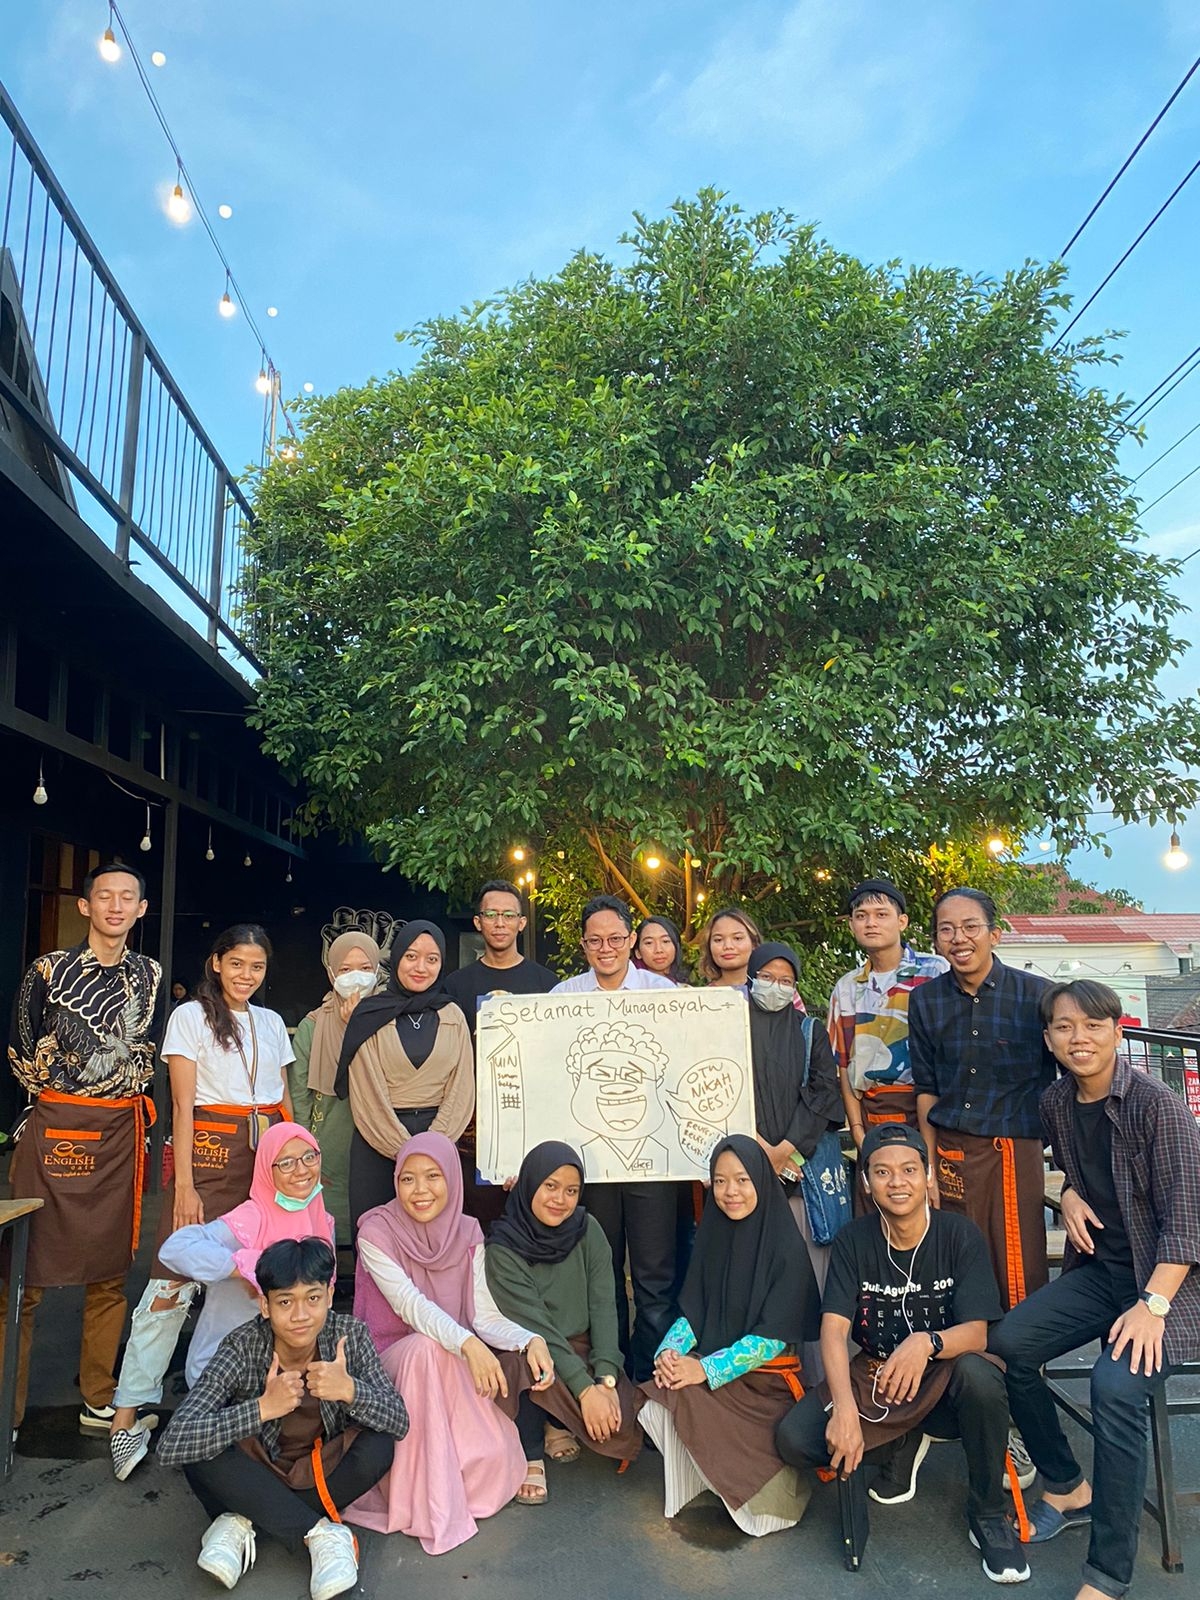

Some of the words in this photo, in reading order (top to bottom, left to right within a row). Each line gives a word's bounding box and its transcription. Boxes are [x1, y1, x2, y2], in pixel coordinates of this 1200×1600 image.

[494, 1001, 595, 1025] Selamat
[606, 996, 721, 1023] Munaqasyah
[494, 1056, 518, 1068] UIN
[687, 1062, 723, 1084] OTW
[691, 1073, 731, 1098] NIKAH
[44, 1155, 95, 1165] ENGLISH
